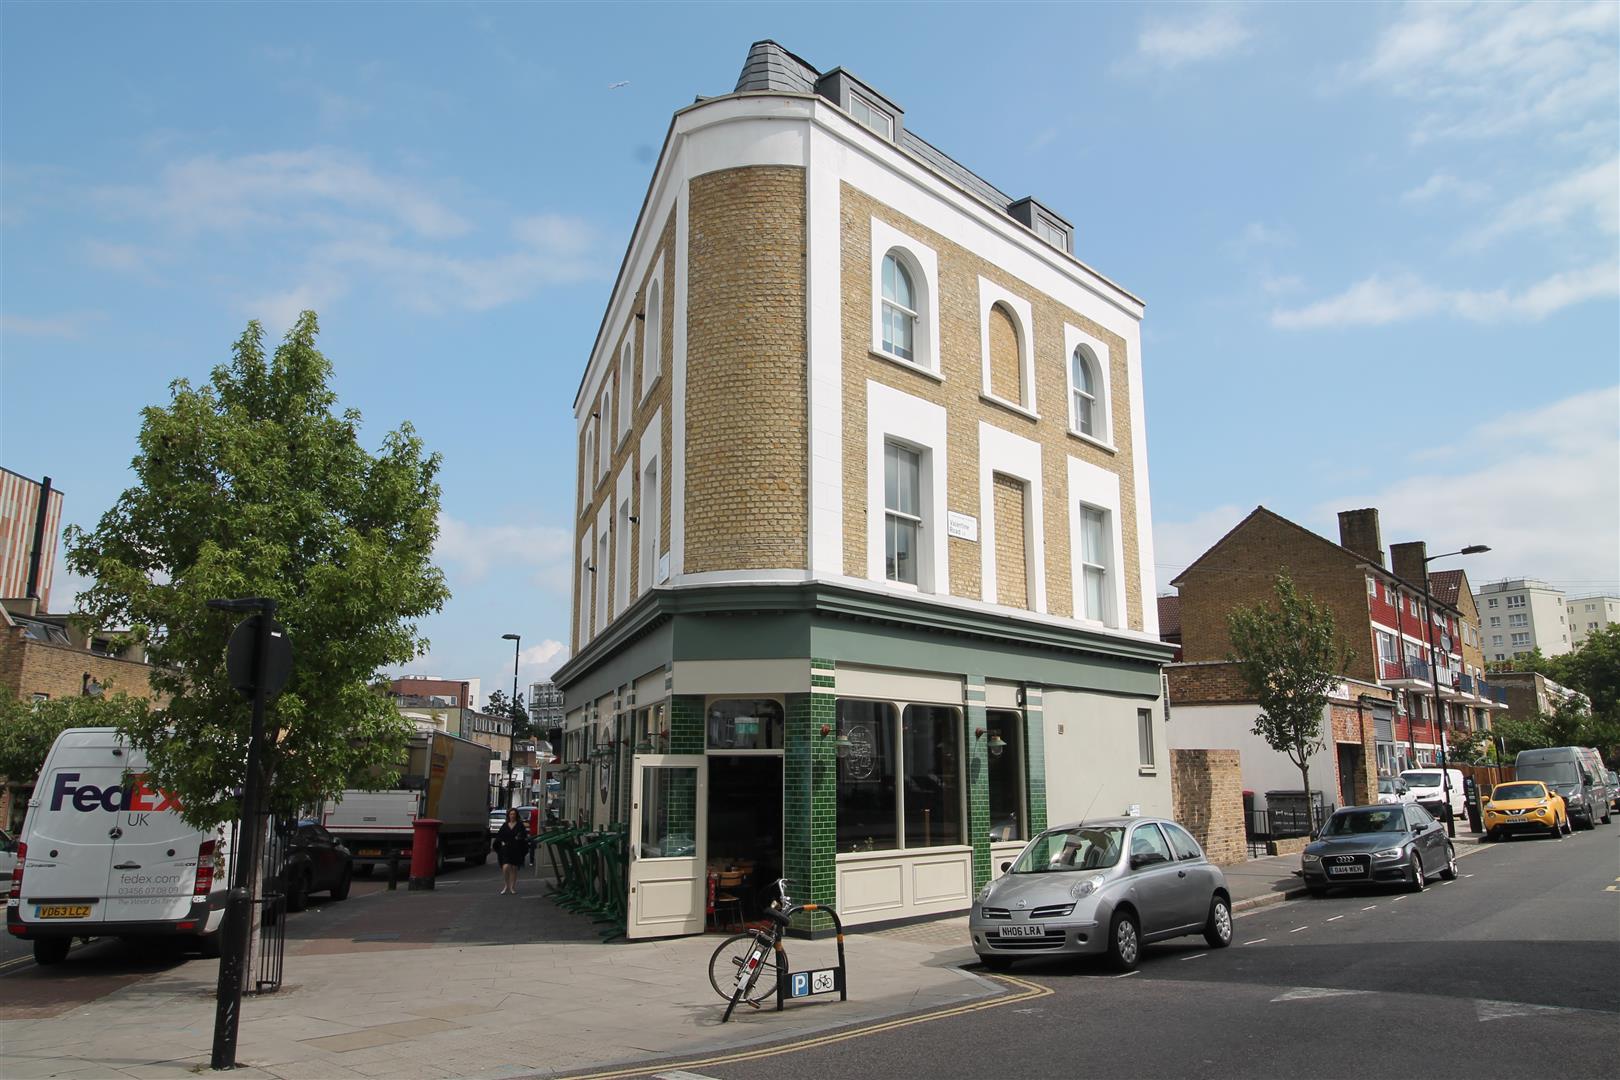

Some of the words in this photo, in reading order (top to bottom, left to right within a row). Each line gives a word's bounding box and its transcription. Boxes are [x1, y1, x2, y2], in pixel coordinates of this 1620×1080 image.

[50, 773, 187, 812] FedEx
[127, 813, 150, 826] UK
[120, 873, 180, 884] fedex.com
[41, 906, 67, 916] VD63
[68, 906, 89, 916] LCZ
[1002, 926, 1023, 936] NH06
[1024, 926, 1042, 936] LRA
[795, 974, 806, 995] P
